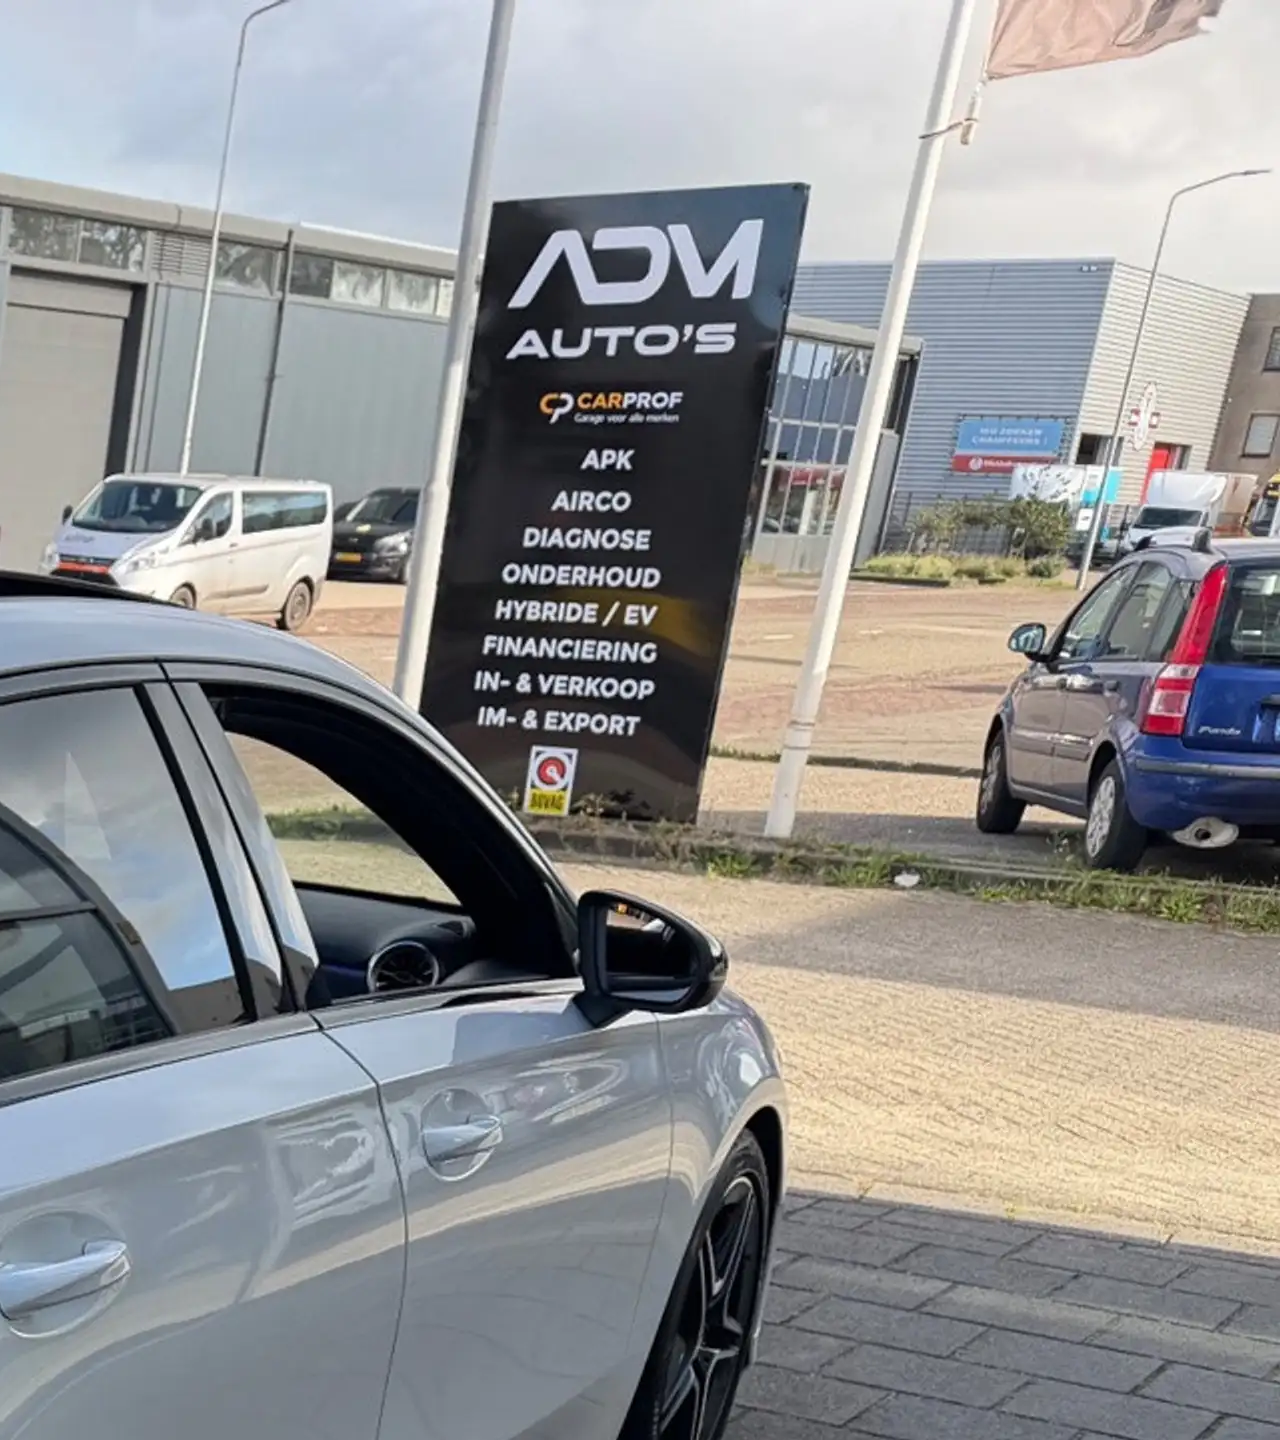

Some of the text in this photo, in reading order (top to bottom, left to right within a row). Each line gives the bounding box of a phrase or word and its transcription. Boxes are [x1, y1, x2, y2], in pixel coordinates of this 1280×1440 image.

[506, 218, 765, 310] ADM
[505, 322, 738, 360] AUTO'S
[577, 391, 684, 409] CARPROF
[580, 449, 635, 470] APK
[551, 490, 632, 512] AIRCO
[522, 526, 651, 550] DIAGNOSE
[502, 563, 661, 588] ONDERHOUD
[494, 599, 658, 627] HYBRIDE / EV
[482, 634, 658, 663] FINANCIERING
[474, 670, 655, 700] IN- & VERKOOP
[477, 706, 641, 736] IM- & EXPORT
